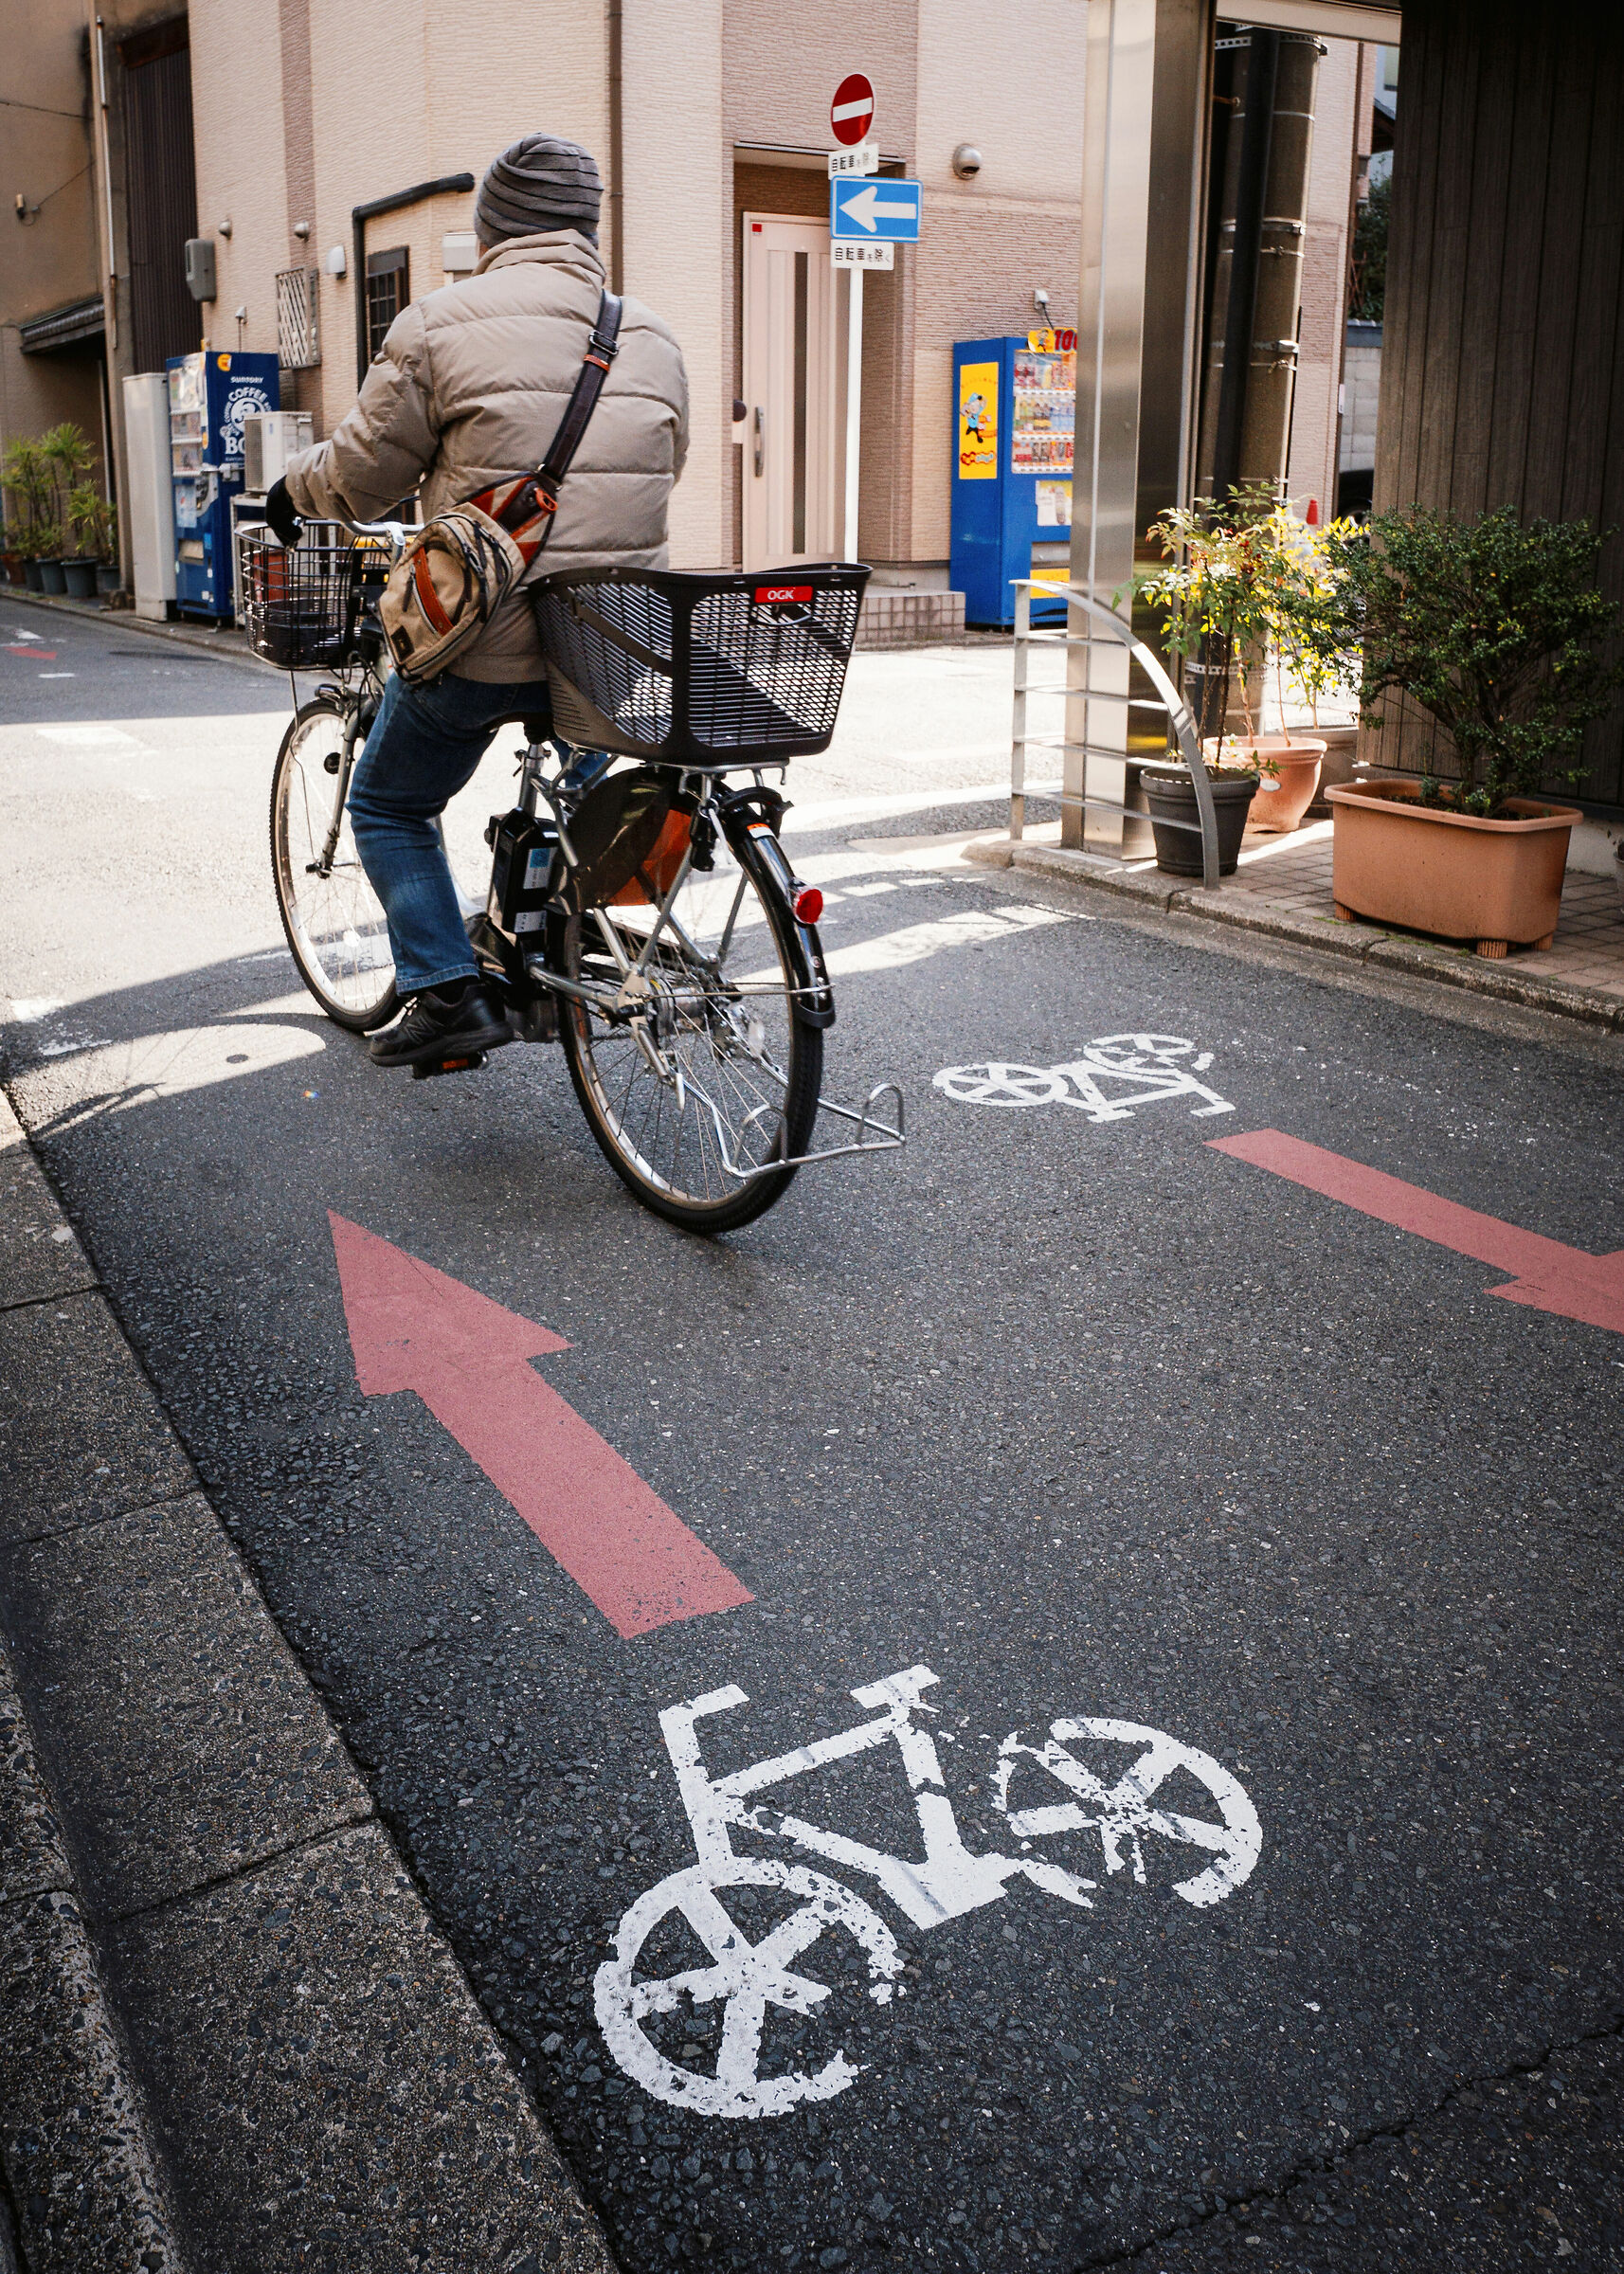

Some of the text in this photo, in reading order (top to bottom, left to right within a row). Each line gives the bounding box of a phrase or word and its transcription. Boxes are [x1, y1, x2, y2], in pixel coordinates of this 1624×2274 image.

[832, 152, 875, 171] 自転車を除
[1055, 329, 1077, 352] 10
[228, 387, 267, 403] COFFEE
[767, 589, 794, 600] OGK
